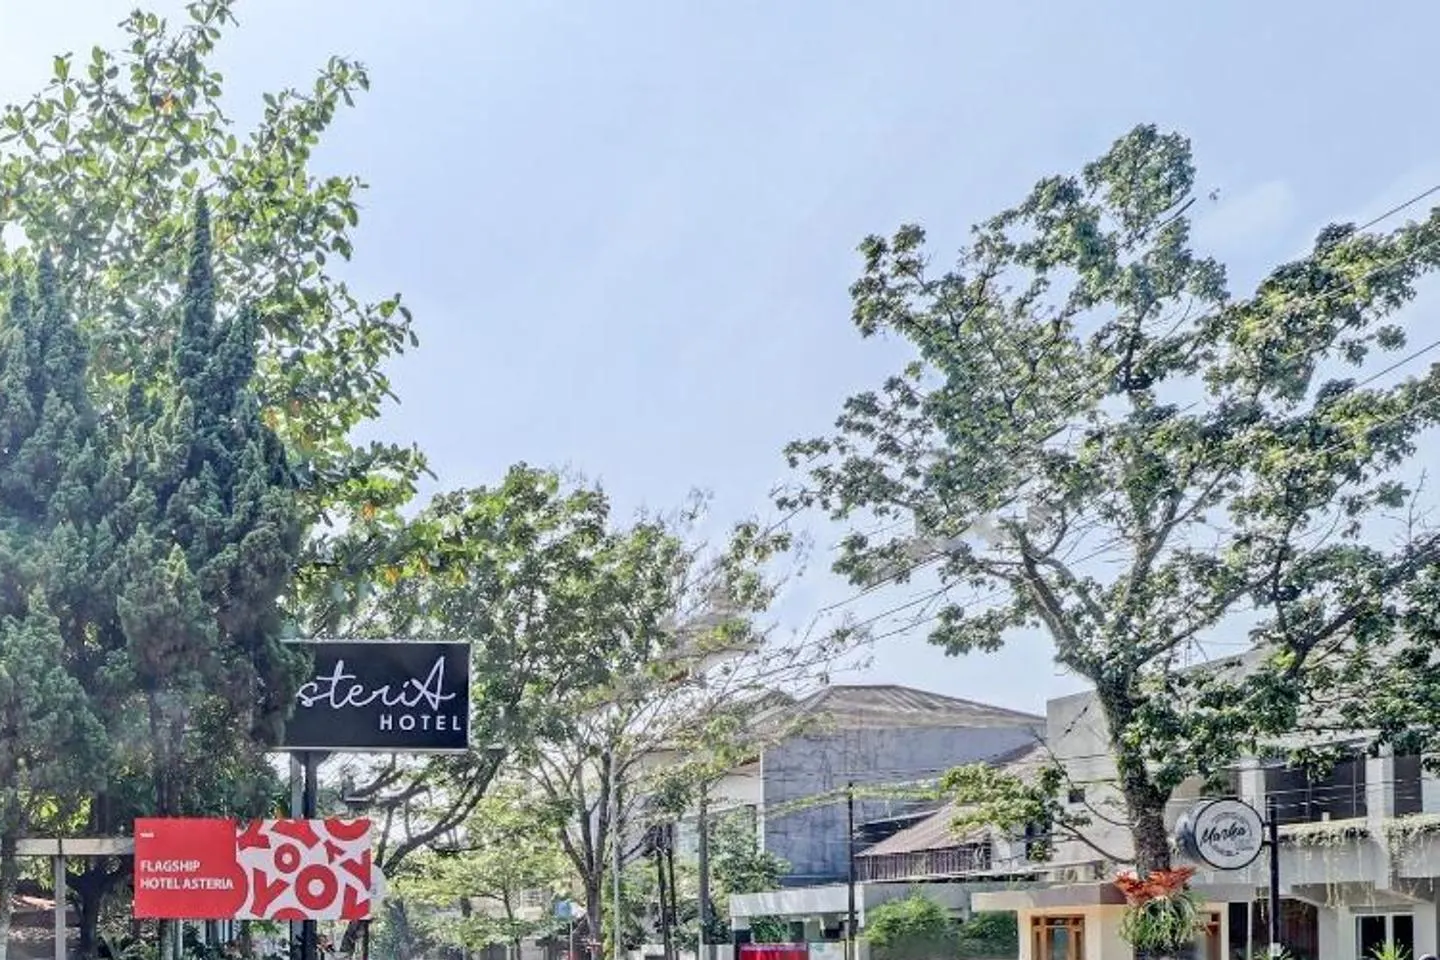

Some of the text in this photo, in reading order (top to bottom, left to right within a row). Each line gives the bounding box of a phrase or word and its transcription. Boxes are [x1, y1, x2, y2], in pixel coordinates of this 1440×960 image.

[295, 655, 457, 711] steriA
[379, 713, 462, 731] HOTEL
[140, 859, 201, 873] FLAGSHIP
[140, 876, 235, 890] HOTEL ASTERIA
